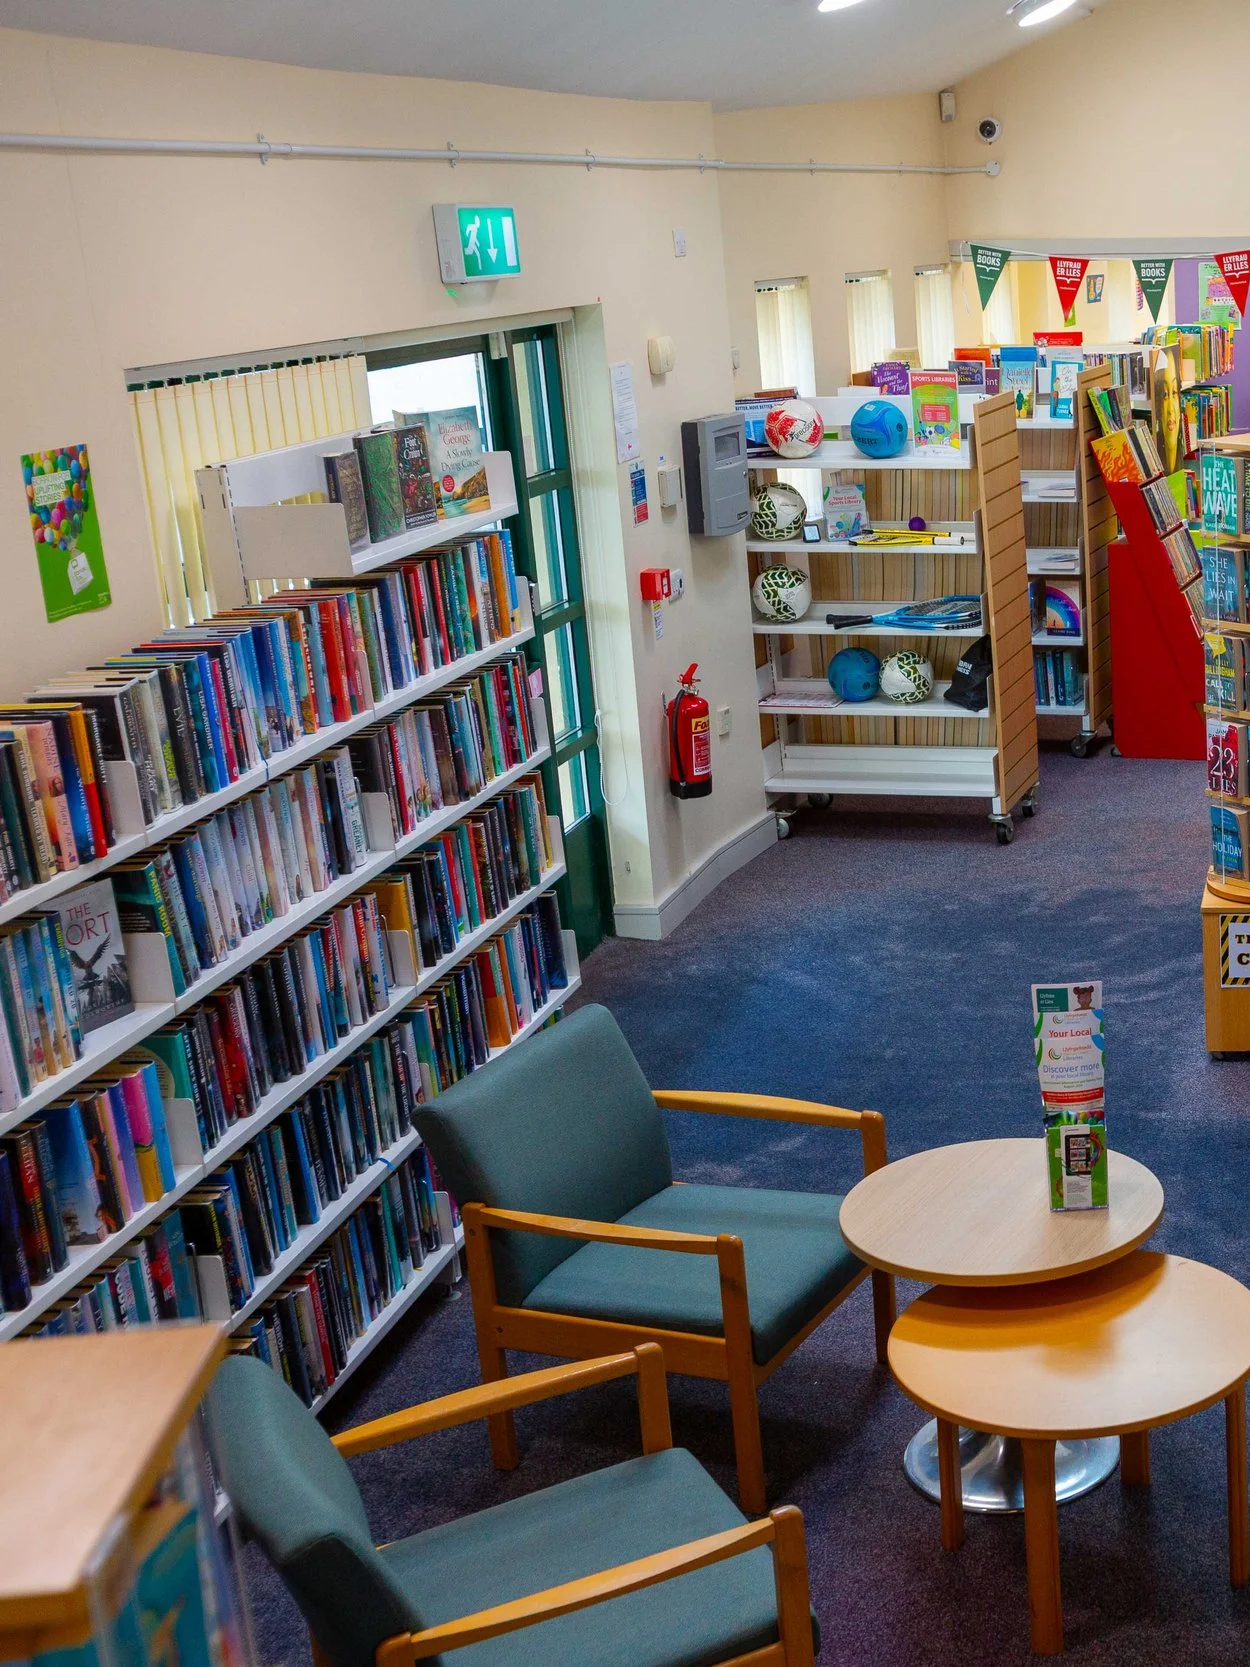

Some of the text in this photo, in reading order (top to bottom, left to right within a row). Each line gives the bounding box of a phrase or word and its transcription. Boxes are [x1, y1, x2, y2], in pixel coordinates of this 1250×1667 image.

[976, 255, 1001, 267] BOOKS
[1057, 261, 1082, 270] LLYFRAU
[1223, 254, 1248, 264] LLYFRAU
[1056, 268, 1081, 277] ER LLES
[1141, 268, 1166, 277] BOOKS
[1223, 263, 1233, 272] ER
[1234, 262, 1249, 271] LLES
[438, 421, 472, 435] Elizabeth
[442, 434, 471, 446] George
[452, 447, 472, 458] Slowly
[441, 460, 480, 473] Dying Cause
[1214, 460, 1224, 469] THE
[1203, 467, 1236, 491] HEAT
[35, 493, 62, 505] STORIES
[1203, 491, 1237, 517] WAVE
[1209, 557, 1228, 569] SHE
[1206, 571, 1236, 584] LIES IN
[1209, 588, 1234, 601] WAIT
[171, 706, 187, 737] EVIL
[196, 690, 216, 750] LISA GARDNER
[1210, 746, 1235, 776] 23
[349, 818, 363, 854] GREANEY
[1212, 842, 1242, 858] HOLIDAY
[147, 870, 172, 937] PANIC ROOM
[65, 902, 91, 921] THE
[65, 911, 110, 945] ORT
[1049, 1028, 1092, 1038] Your Local
[1043, 1062, 1100, 1074] Discover more
[16, 1139, 37, 1184] FEEHAN
